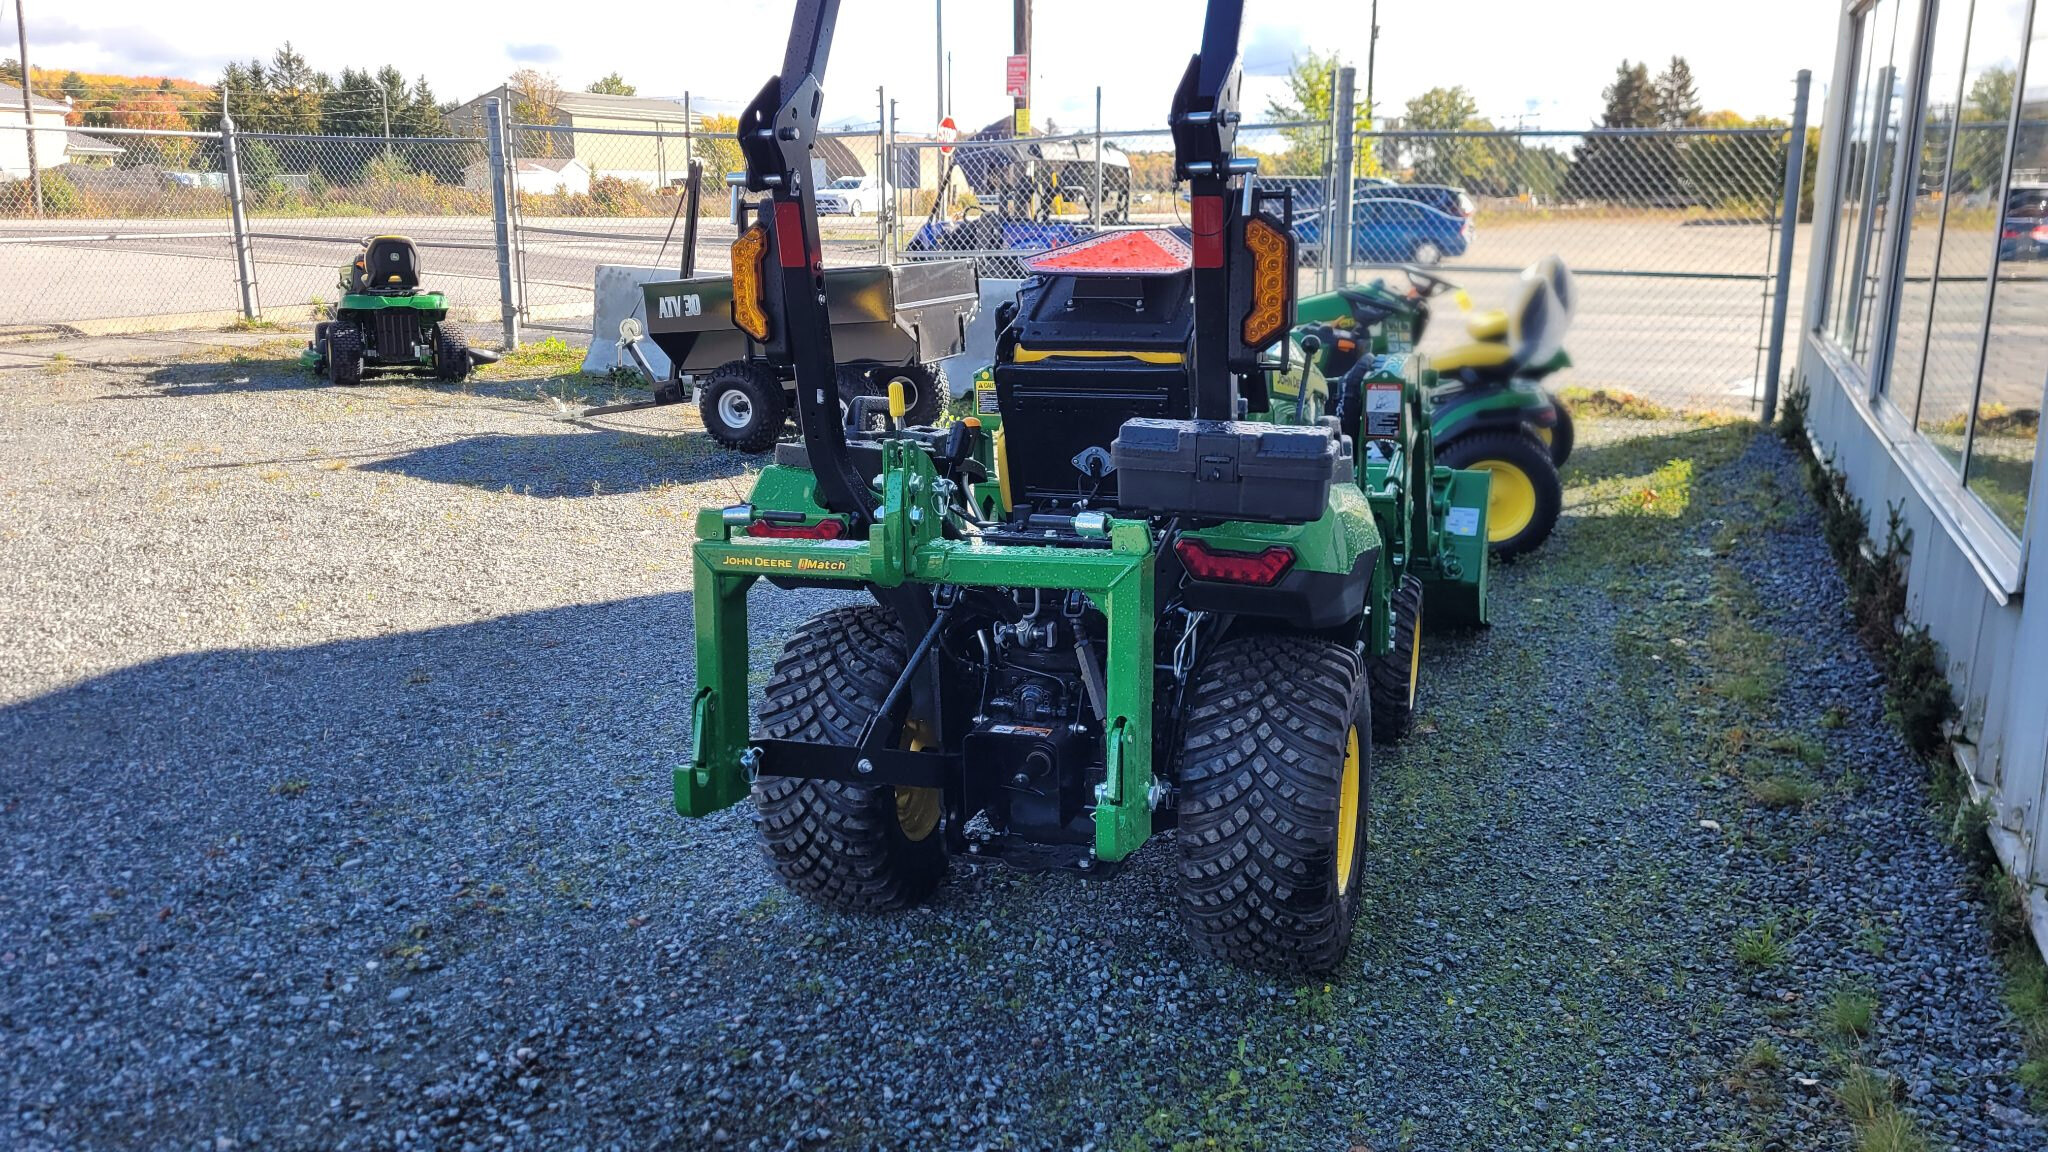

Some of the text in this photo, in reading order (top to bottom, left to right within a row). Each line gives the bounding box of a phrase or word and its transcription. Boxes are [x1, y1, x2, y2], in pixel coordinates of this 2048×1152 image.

[658, 293, 701, 319] ATV 30
[723, 556, 752, 566] JOHN
[755, 557, 792, 568] DEERE
